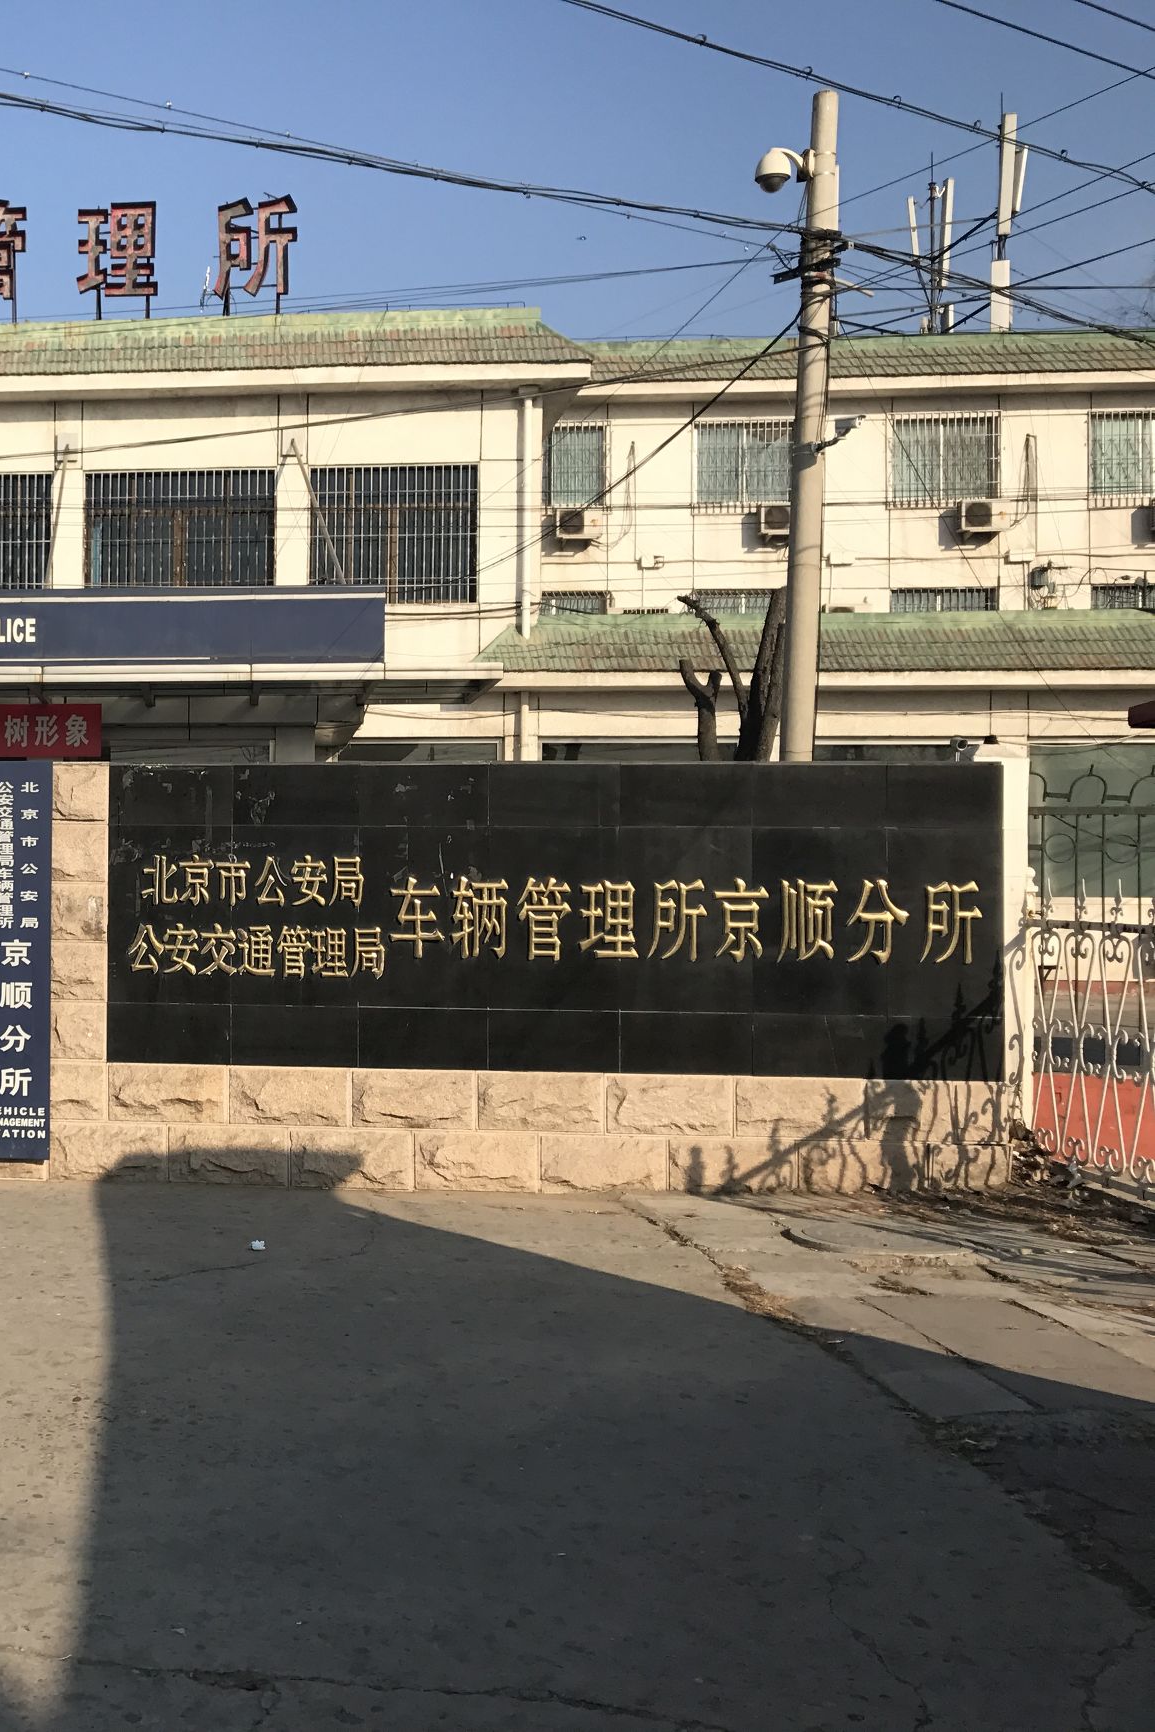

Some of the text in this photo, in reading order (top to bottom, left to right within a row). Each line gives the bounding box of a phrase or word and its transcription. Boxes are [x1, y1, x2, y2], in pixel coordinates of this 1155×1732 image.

[20, 781, 40, 929] 北京市公安局
[141, 854, 365, 907] 北京市公安局
[127, 922, 386, 981] 公安交通管理局
[389, 876, 983, 964] 车辆管理所京顺分所
[0, 938, 33, 1097] 京顺分所
